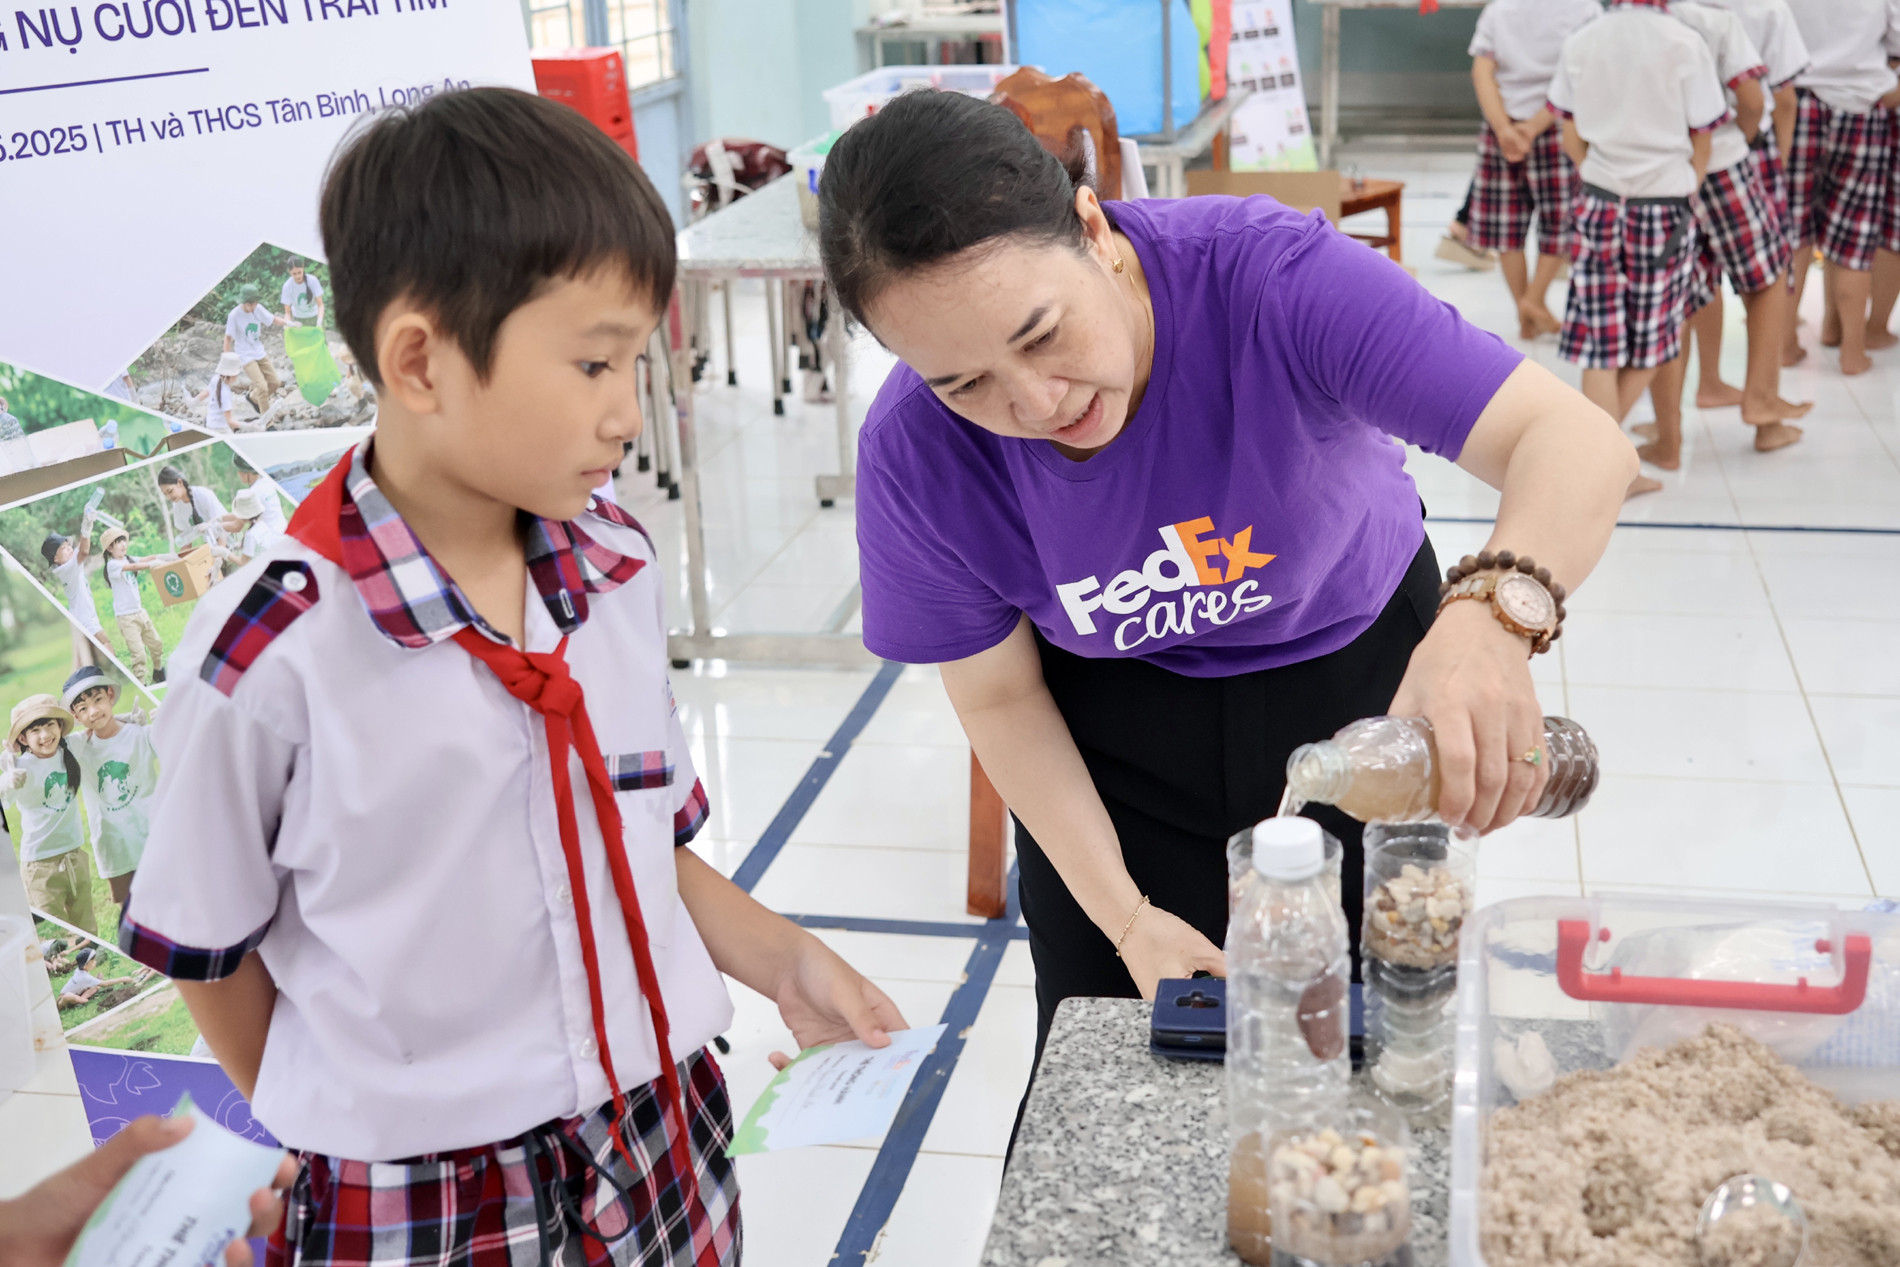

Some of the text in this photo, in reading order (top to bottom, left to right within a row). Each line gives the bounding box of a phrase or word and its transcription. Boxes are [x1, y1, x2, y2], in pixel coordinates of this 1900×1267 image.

[15, 7, 83, 54] NỤ
[105, 117, 146, 146] TH
[150, 111, 185, 140] và
[187, 102, 262, 135] THCS
[266, 97, 312, 124] Tân
[1055, 515, 1278, 636] FedEx
[1113, 579, 1273, 651] cares
